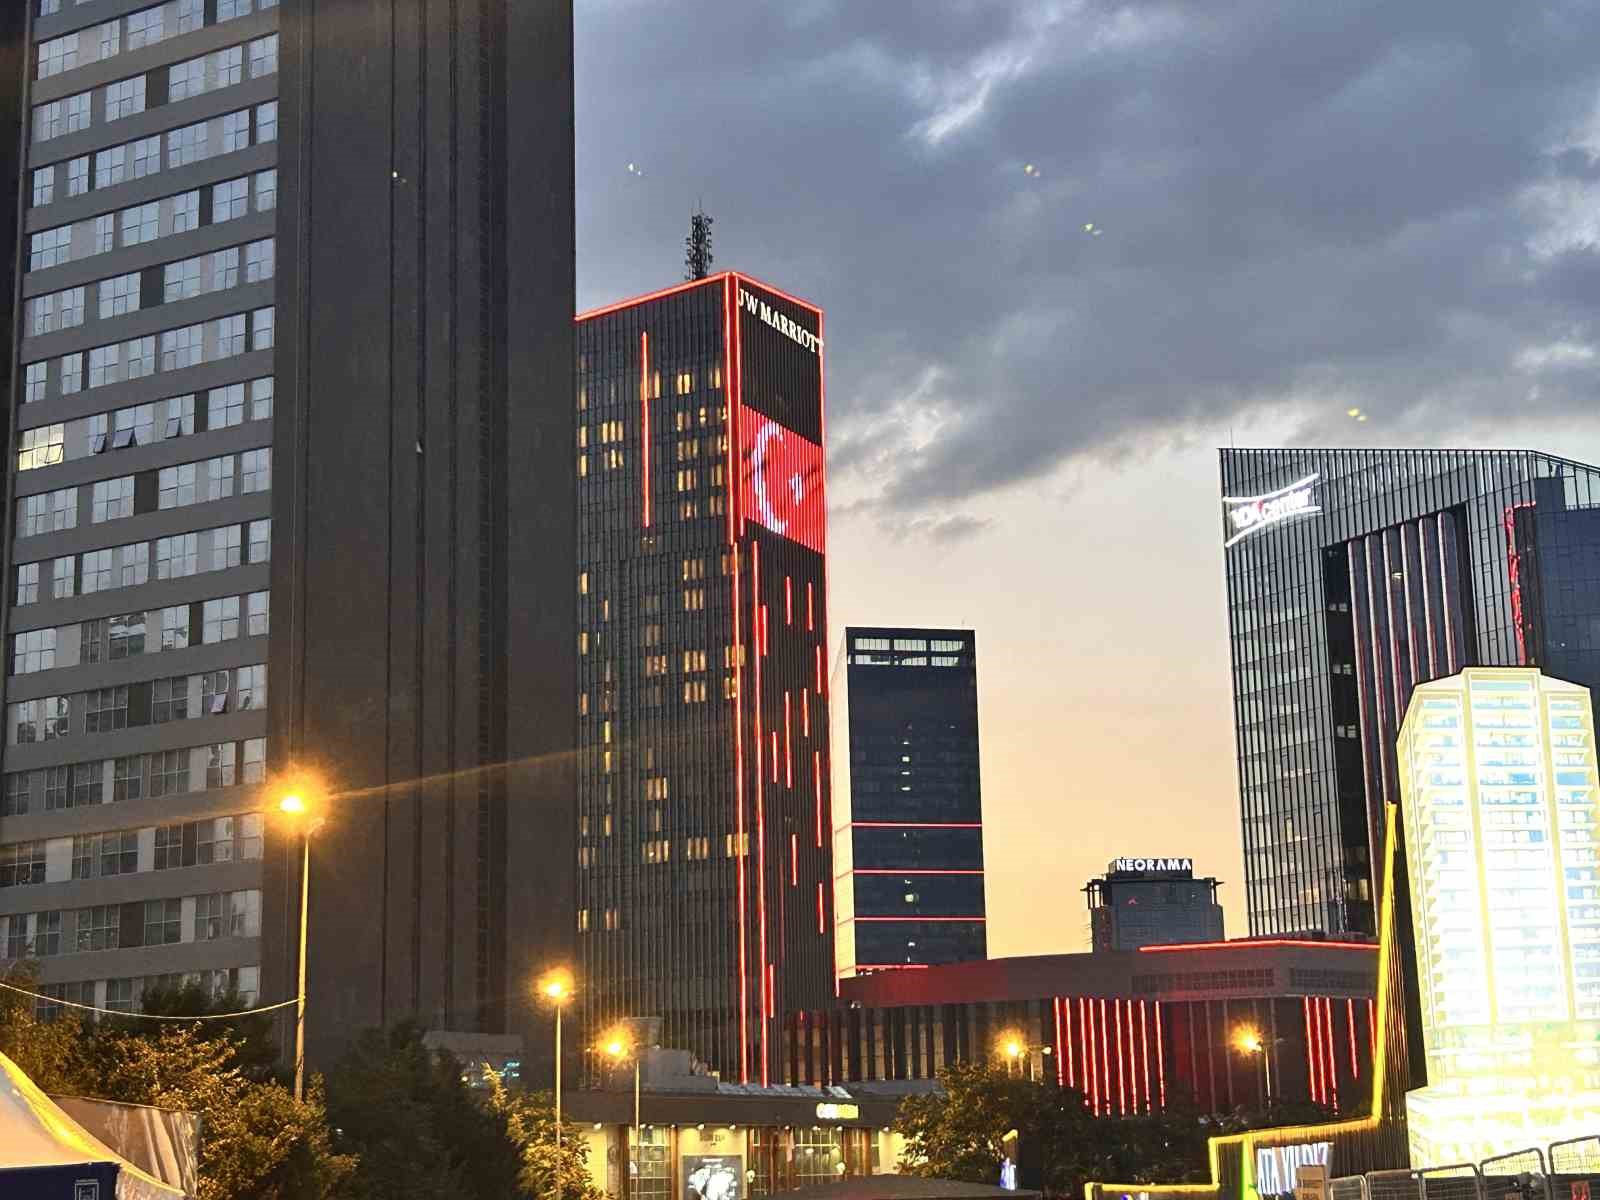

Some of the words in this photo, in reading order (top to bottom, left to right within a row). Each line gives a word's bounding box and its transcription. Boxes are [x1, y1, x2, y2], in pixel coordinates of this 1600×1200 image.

[738, 288, 759, 315] JW
[760, 301, 824, 355] MARRIOTT
[1116, 858, 1192, 872] NEORAMA
